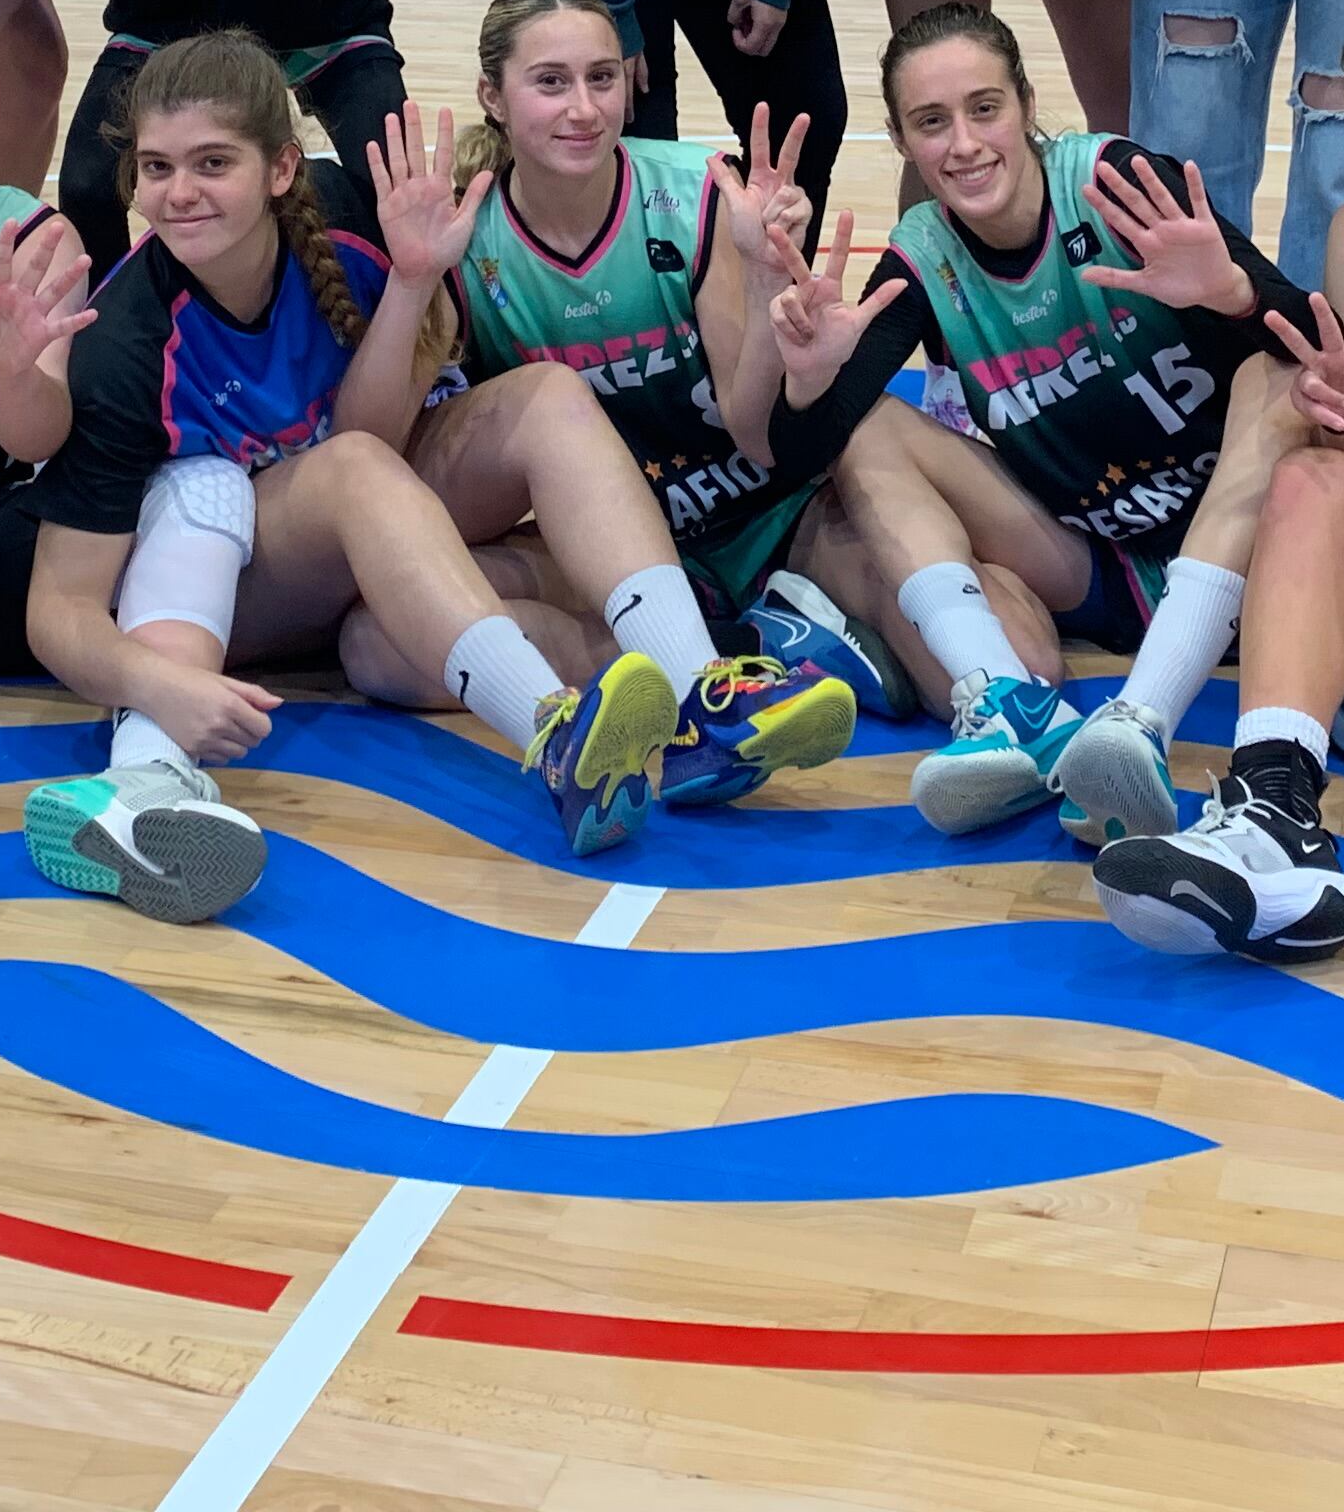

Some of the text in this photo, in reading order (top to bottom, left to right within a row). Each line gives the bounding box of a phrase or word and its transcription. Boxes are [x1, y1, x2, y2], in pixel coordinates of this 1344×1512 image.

[1012, 305, 1048, 327] besten
[1123, 341, 1216, 436] 15
[665, 449, 771, 530] AFIO
